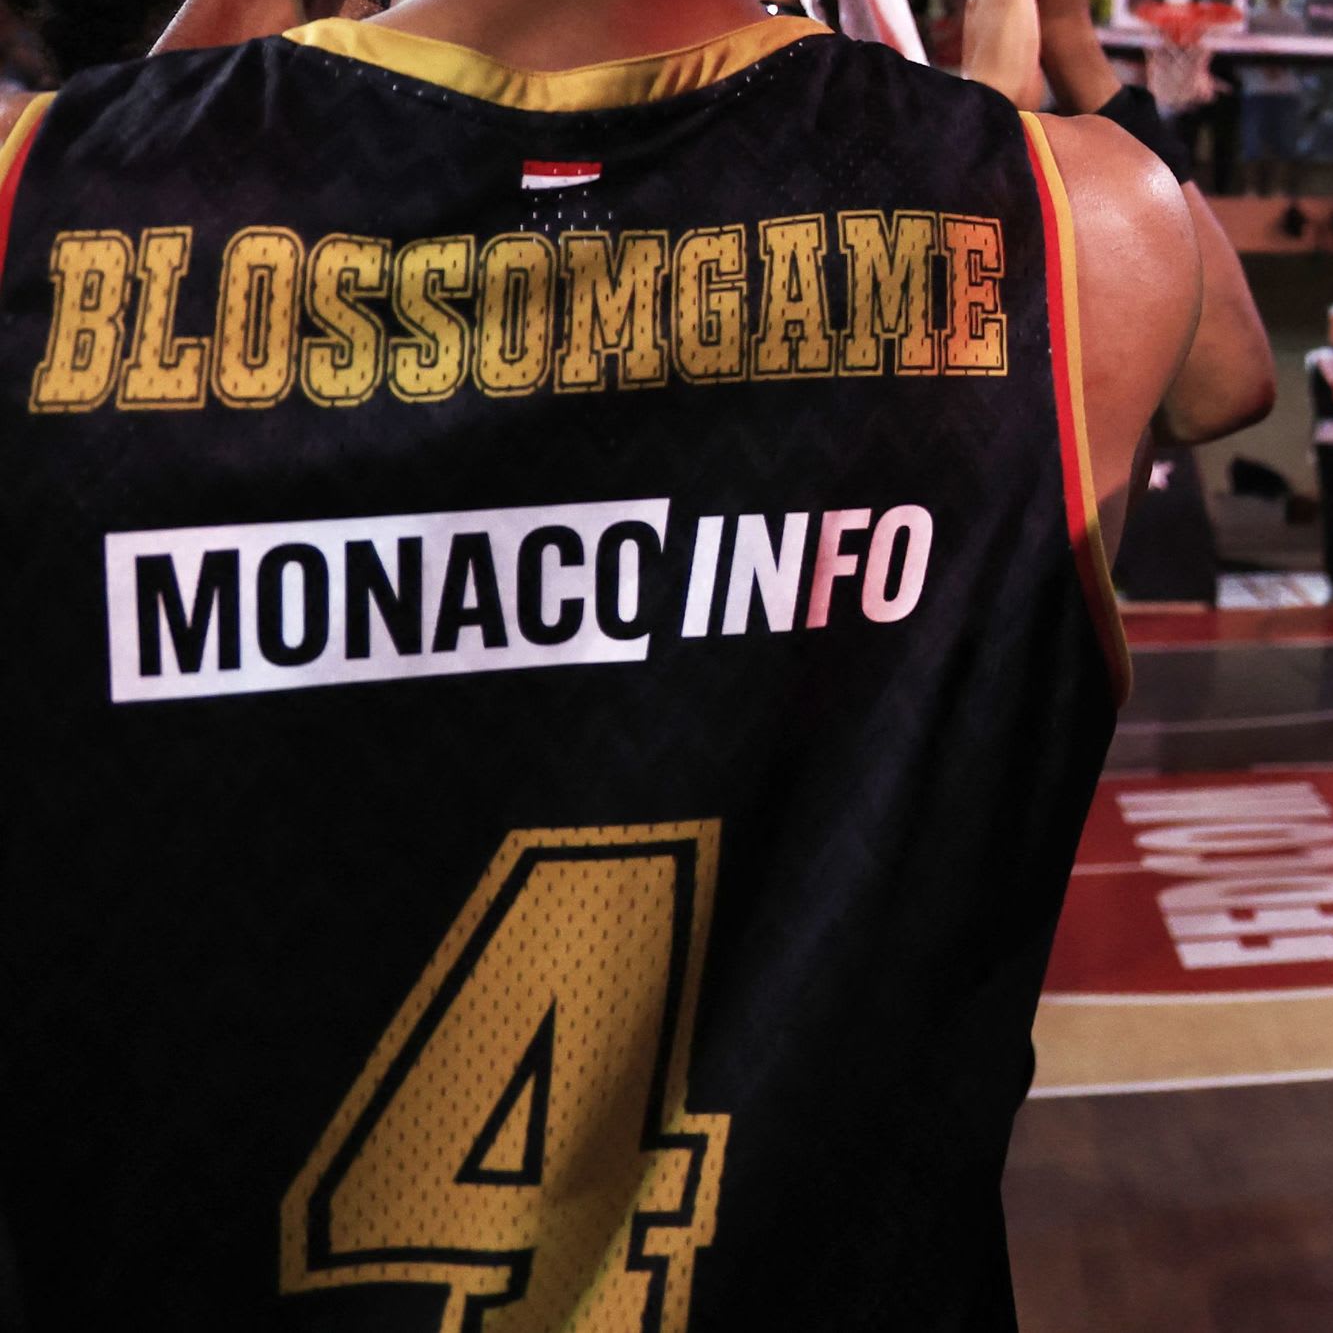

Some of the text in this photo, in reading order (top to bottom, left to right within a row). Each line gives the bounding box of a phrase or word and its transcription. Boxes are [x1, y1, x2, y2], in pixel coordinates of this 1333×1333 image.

[28, 208, 1009, 413] BLOSSOMGAME
[134, 503, 933, 677] MONACO INFO
[279, 817, 732, 1333] 4
